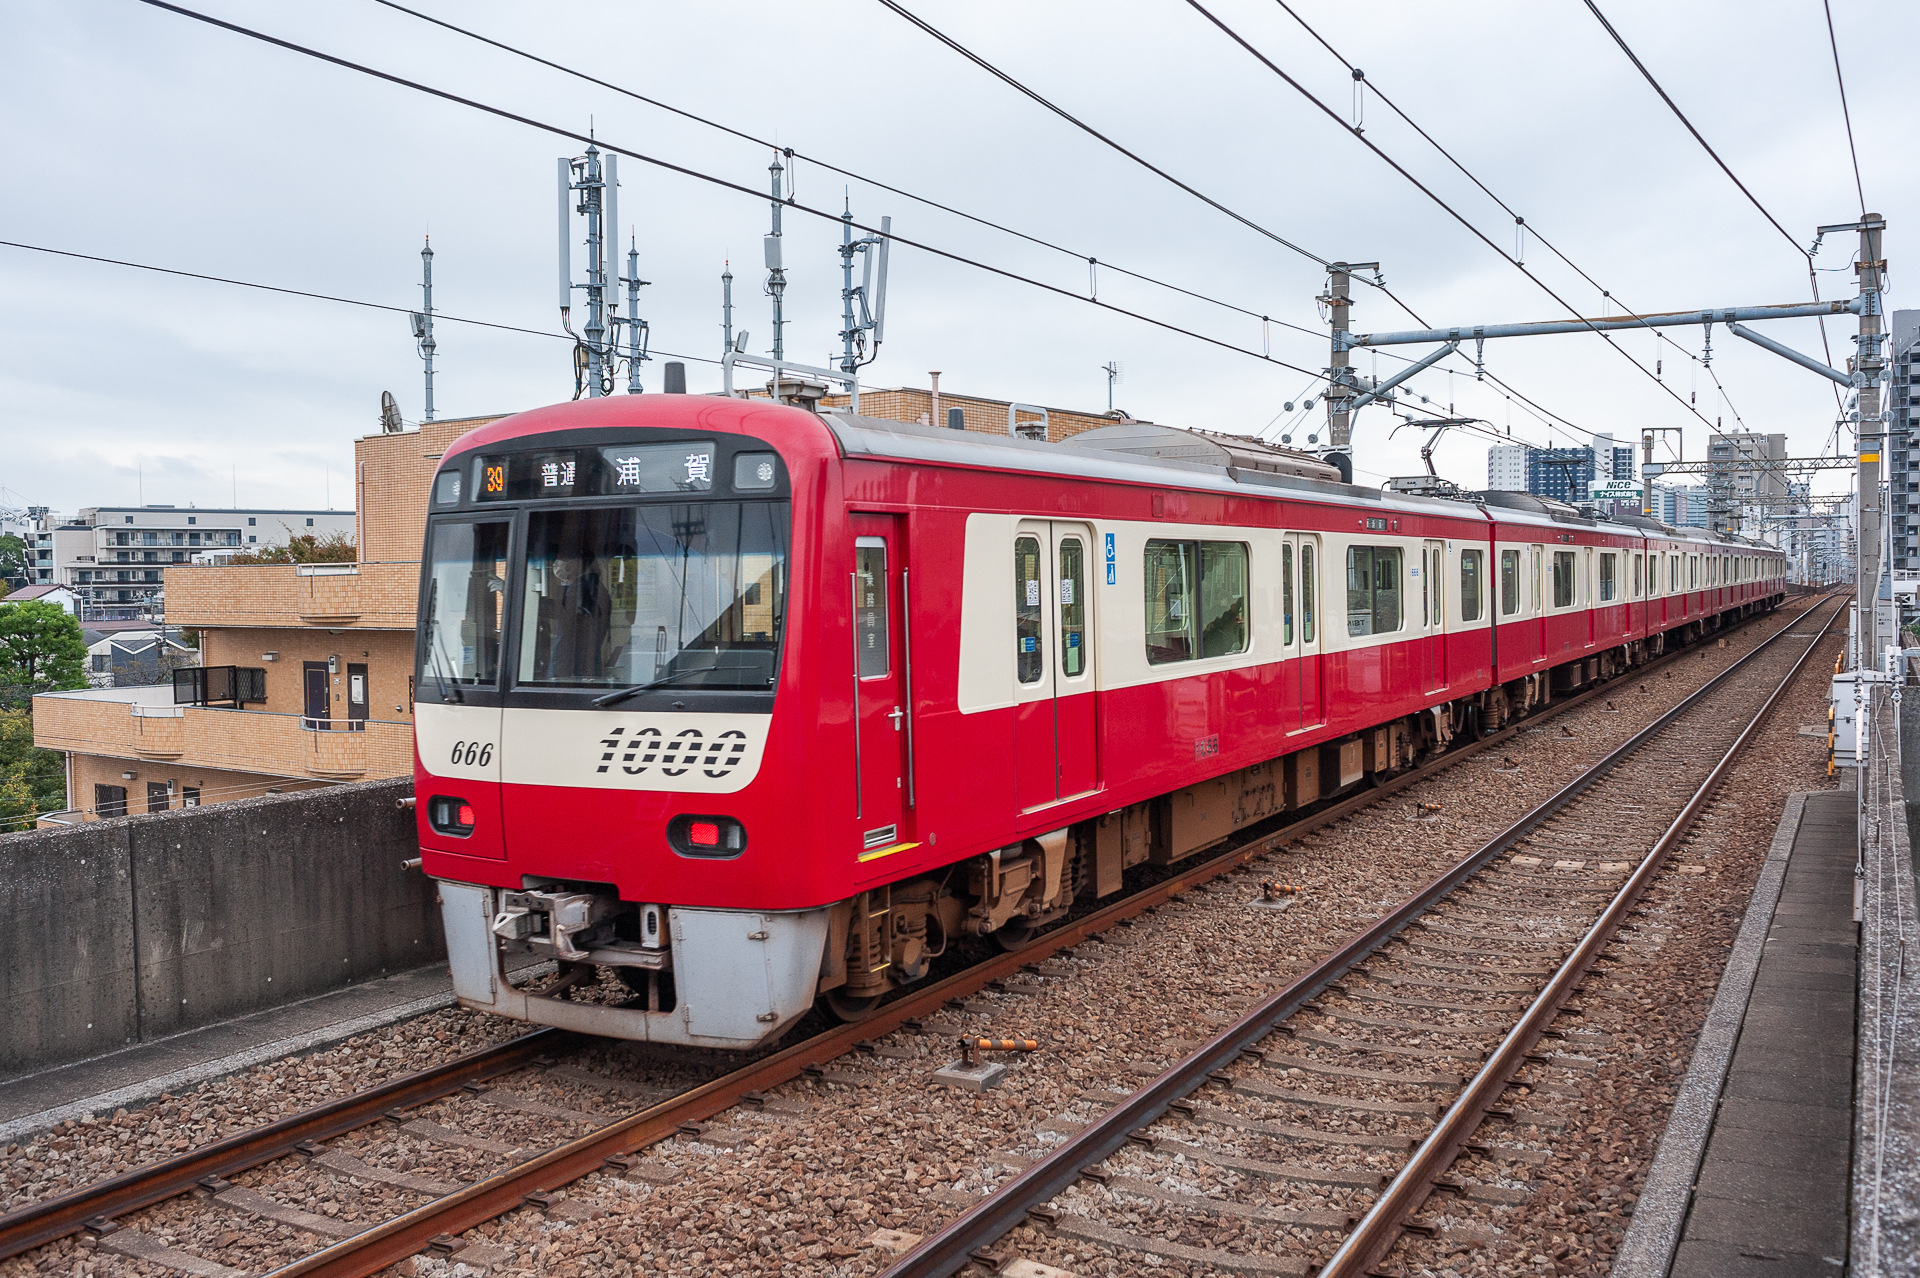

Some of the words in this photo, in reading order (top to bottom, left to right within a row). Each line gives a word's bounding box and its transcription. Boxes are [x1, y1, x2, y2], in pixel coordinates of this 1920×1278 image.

[487, 466, 503, 492] 39
[541, 461, 576, 487] 普通
[616, 453, 710, 485] 浦賀
[451, 740, 494, 767] 666
[596, 727, 747, 779] 1000
